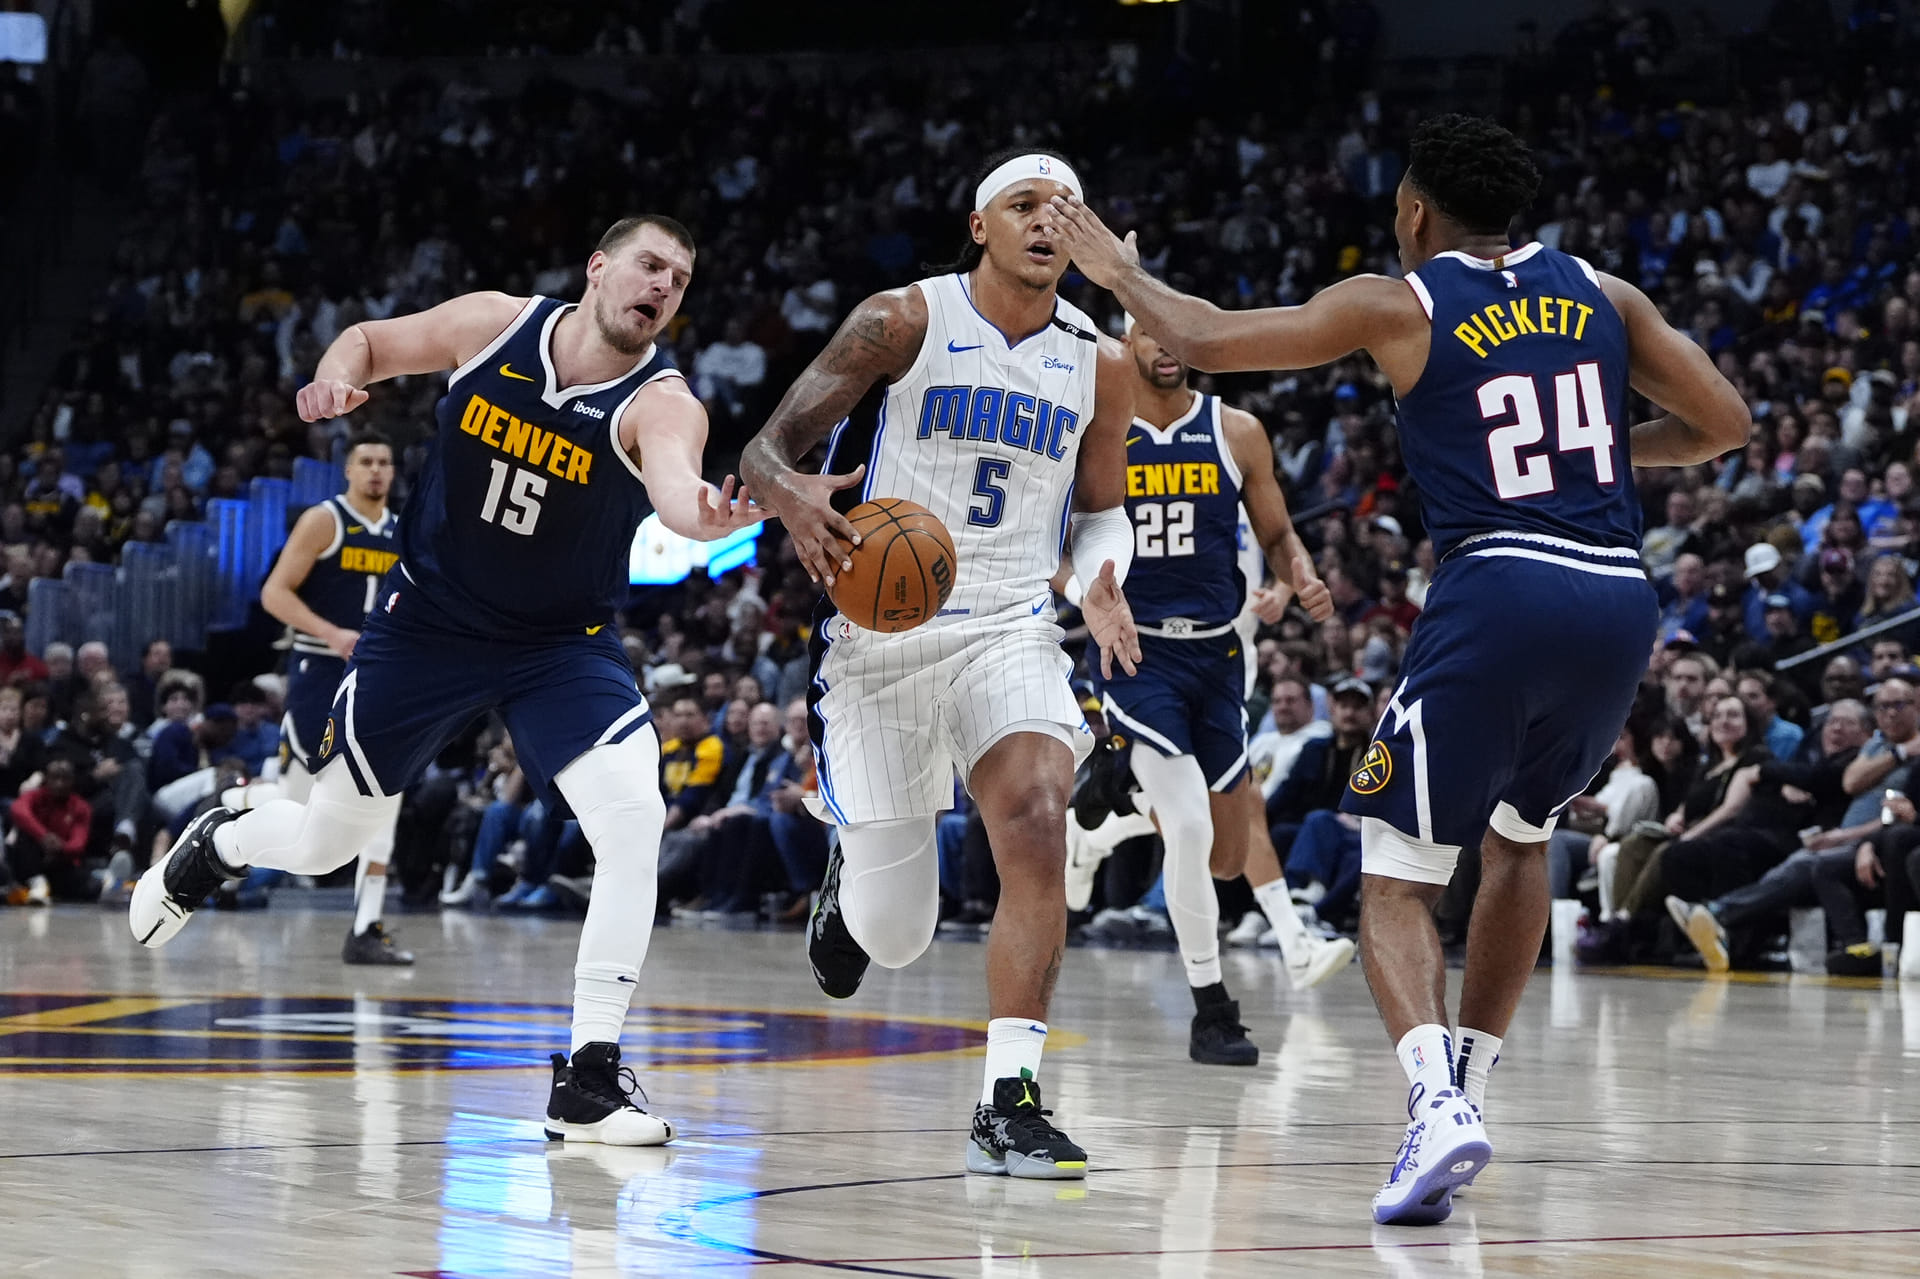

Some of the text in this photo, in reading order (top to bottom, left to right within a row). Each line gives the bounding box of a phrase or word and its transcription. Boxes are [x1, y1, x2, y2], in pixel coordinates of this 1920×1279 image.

[1065, 324, 1080, 335] PW
[1453, 296, 1594, 358] PICKETT
[1040, 355, 1075, 375] Disney
[459, 394, 593, 485] DENVER
[573, 400, 606, 420] ibotta
[916, 385, 1079, 462] MAGIC
[1181, 432, 1212, 443] ibotta
[1476, 361, 1614, 499] 24
[480, 458, 548, 536] 15
[967, 456, 1011, 528] 5
[1124, 462, 1220, 497] ENVER
[1135, 501, 1195, 557] 22
